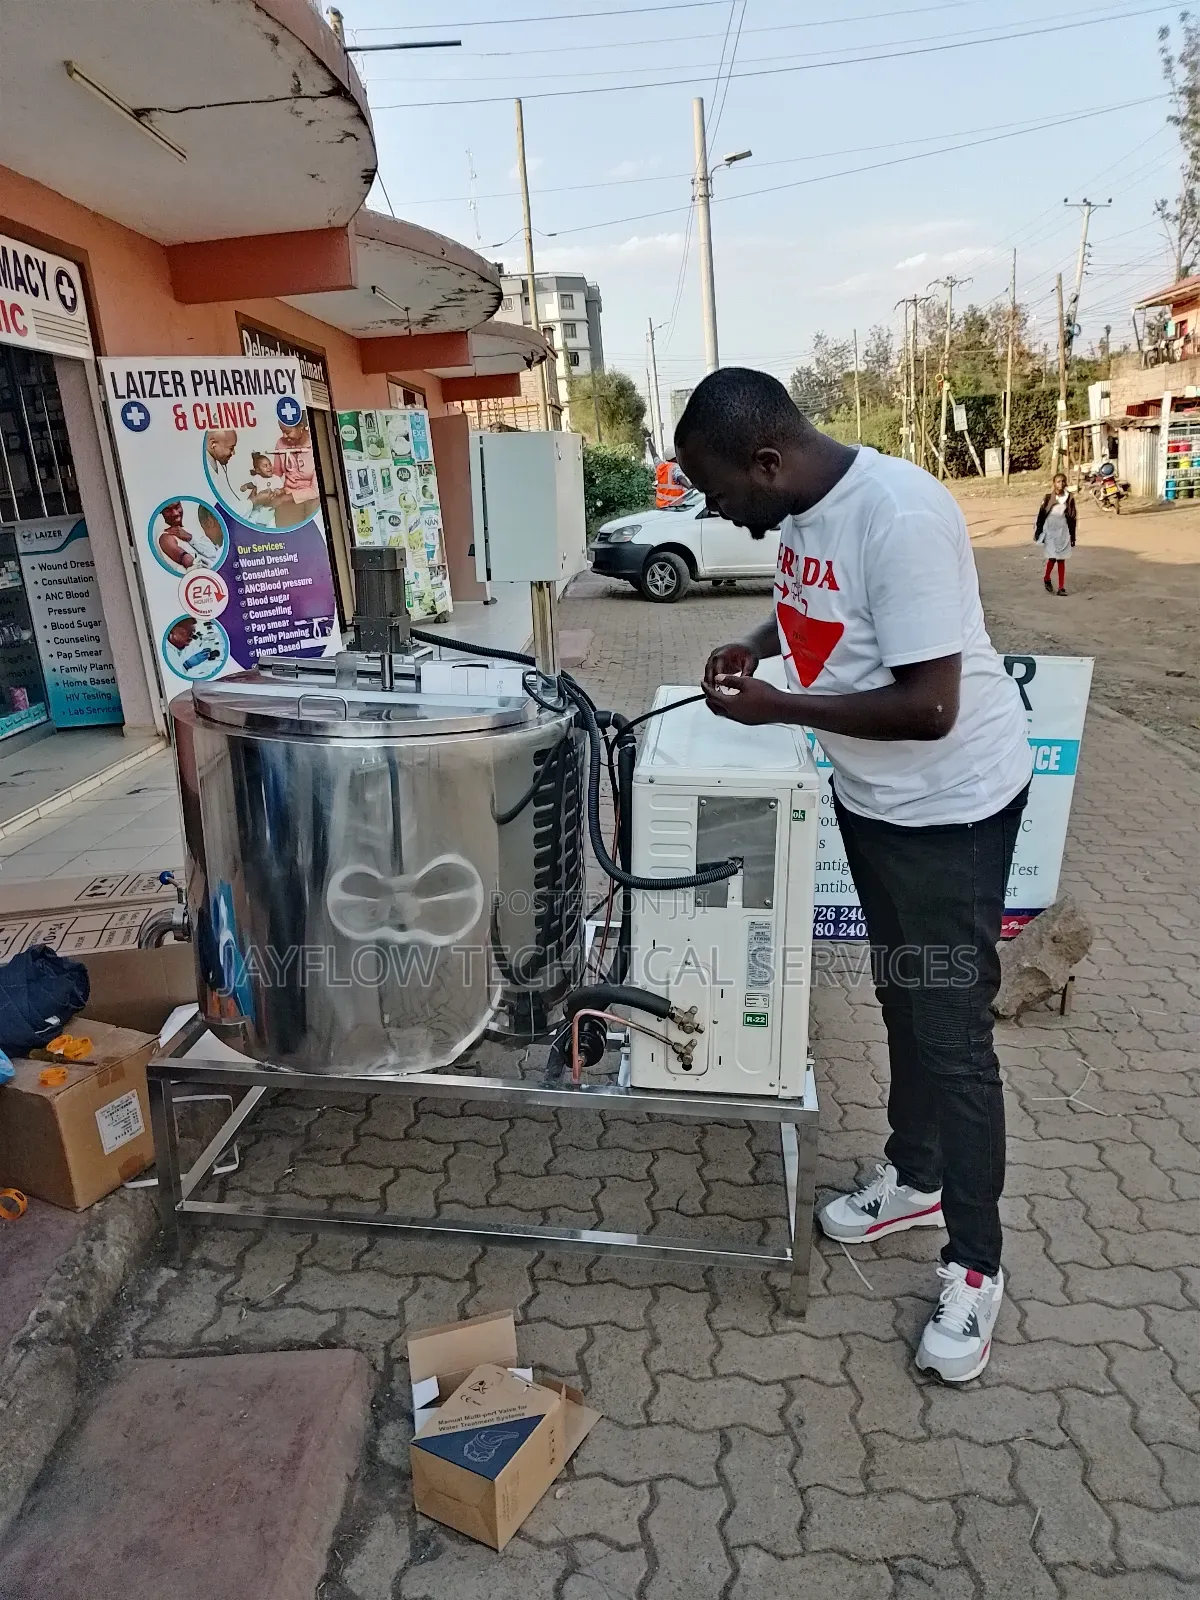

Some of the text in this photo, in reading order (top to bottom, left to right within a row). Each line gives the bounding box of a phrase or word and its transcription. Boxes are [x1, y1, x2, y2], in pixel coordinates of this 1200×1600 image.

[0, 300, 28, 337] IC
[110, 369, 296, 399] LAIZER PHARMACY
[173, 402, 257, 431] & CLINIC
[35, 530, 62, 539] LAIZER
[238, 543, 285, 554] Our Services:
[38, 560, 95, 571] Wound Dress
[239, 553, 298, 567] Wound Dressing
[42, 575, 93, 586] Consultation
[242, 568, 289, 581] Consultation
[283, 577, 312, 590] pressure
[45, 590, 89, 601] ANC Blood
[193, 585, 212, 599] 24
[247, 593, 290, 606] Blood sugar
[48, 606, 86, 616] Pressure
[249, 606, 292, 619] Counselling
[51, 620, 102, 630] Blood Sugar
[251, 620, 290, 633] Pap smear
[54, 634, 100, 644] Counseling
[254, 628, 310, 645] Family Planning
[57, 649, 102, 660] Pap Smear
[256, 643, 301, 657] Home Based
[60, 662, 114, 673] Family Plann
[90, 676, 116, 685] Based
[66, 691, 112, 701] HIV Testing
[69, 705, 122, 716] Lab Services
[813, 922, 834, 936] 80
[438, 1416, 463, 1425] Manual
[464, 1409, 497, 1420] Multi-port
[498, 1406, 517, 1414] Valve
[438, 1412, 525, 1432] Water Treatment Systems
